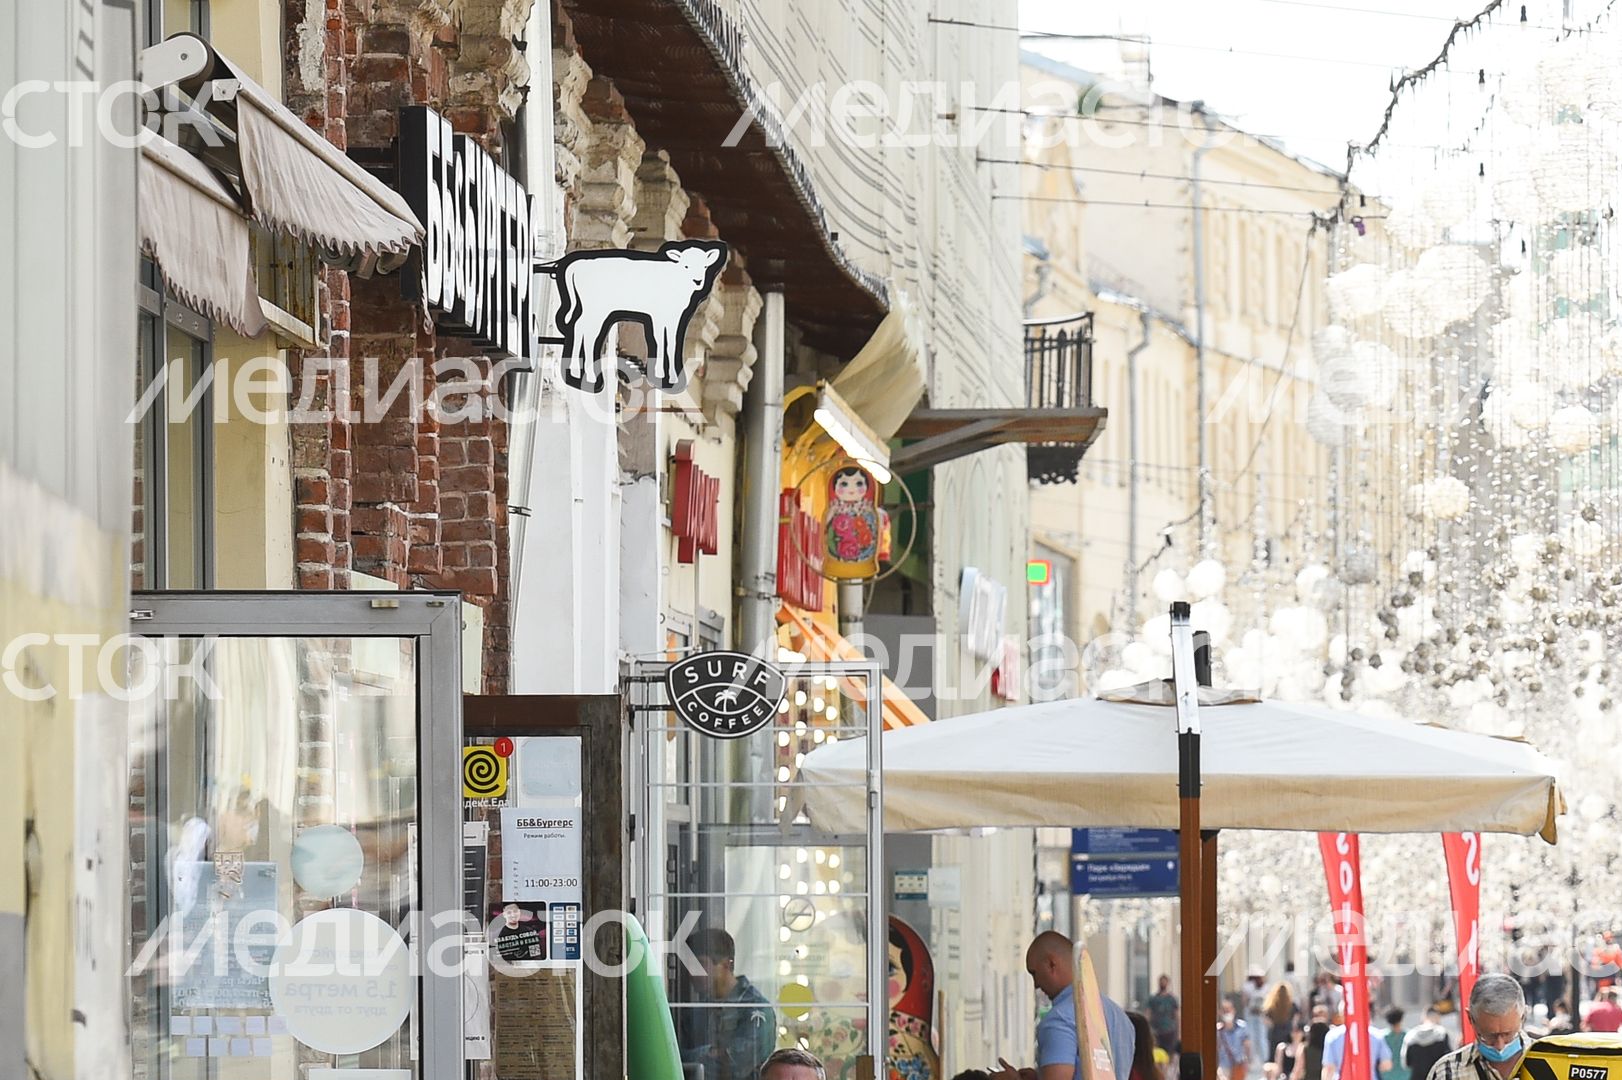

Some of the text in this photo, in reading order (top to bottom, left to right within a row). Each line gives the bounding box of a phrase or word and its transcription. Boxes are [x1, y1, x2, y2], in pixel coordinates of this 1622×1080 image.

[684, 659, 771, 687] SURF
[687, 701, 764, 729] COFFEE
[516, 818, 573, 829] ББ&Бургерс
[525, 879, 578, 888] 11:00-23:00
[1571, 1067, 1607, 1080] P0577
